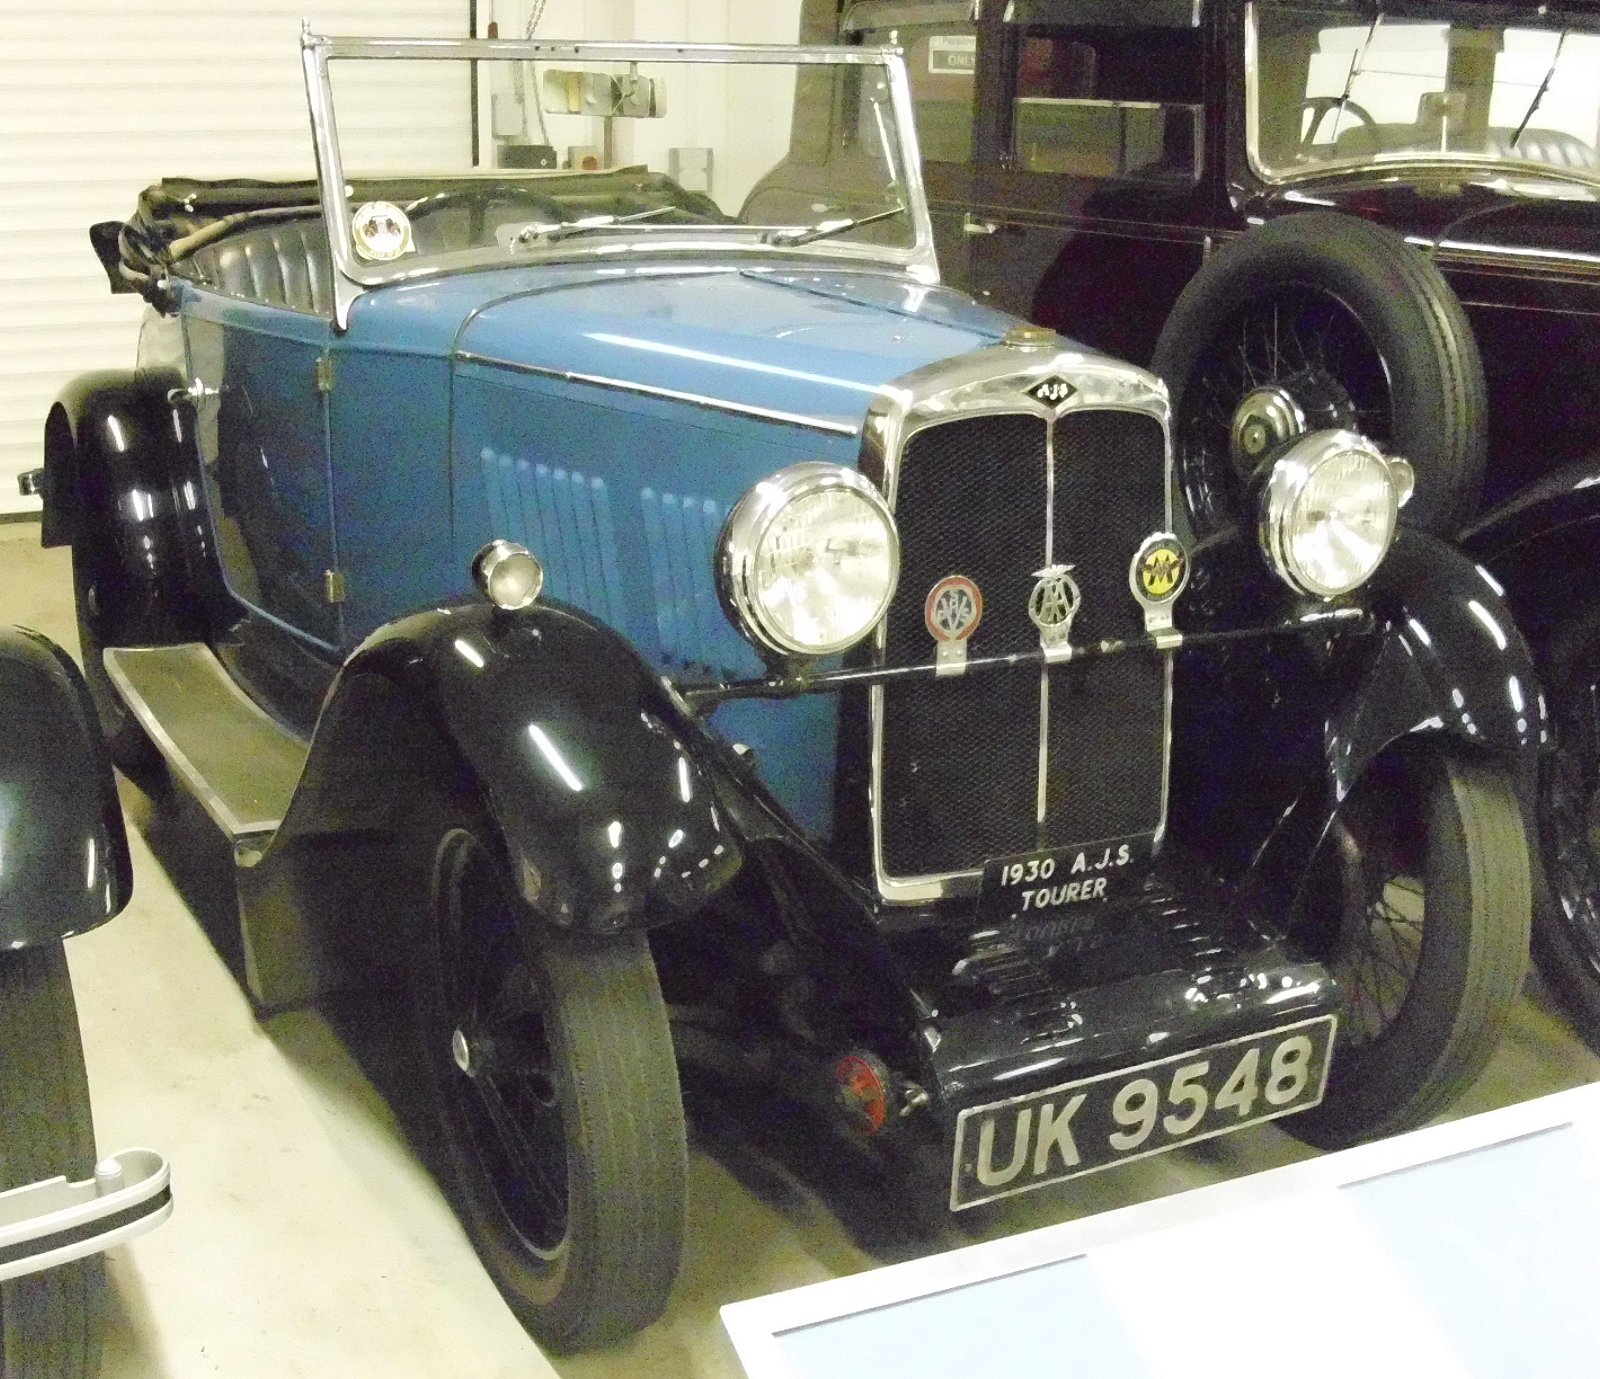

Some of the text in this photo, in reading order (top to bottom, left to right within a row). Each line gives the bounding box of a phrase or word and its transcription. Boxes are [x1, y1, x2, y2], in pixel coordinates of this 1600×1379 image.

[1001, 858, 1056, 887] 1930
[1021, 877, 1108, 912] TOURER
[976, 1035, 1313, 1186] UK 9548
